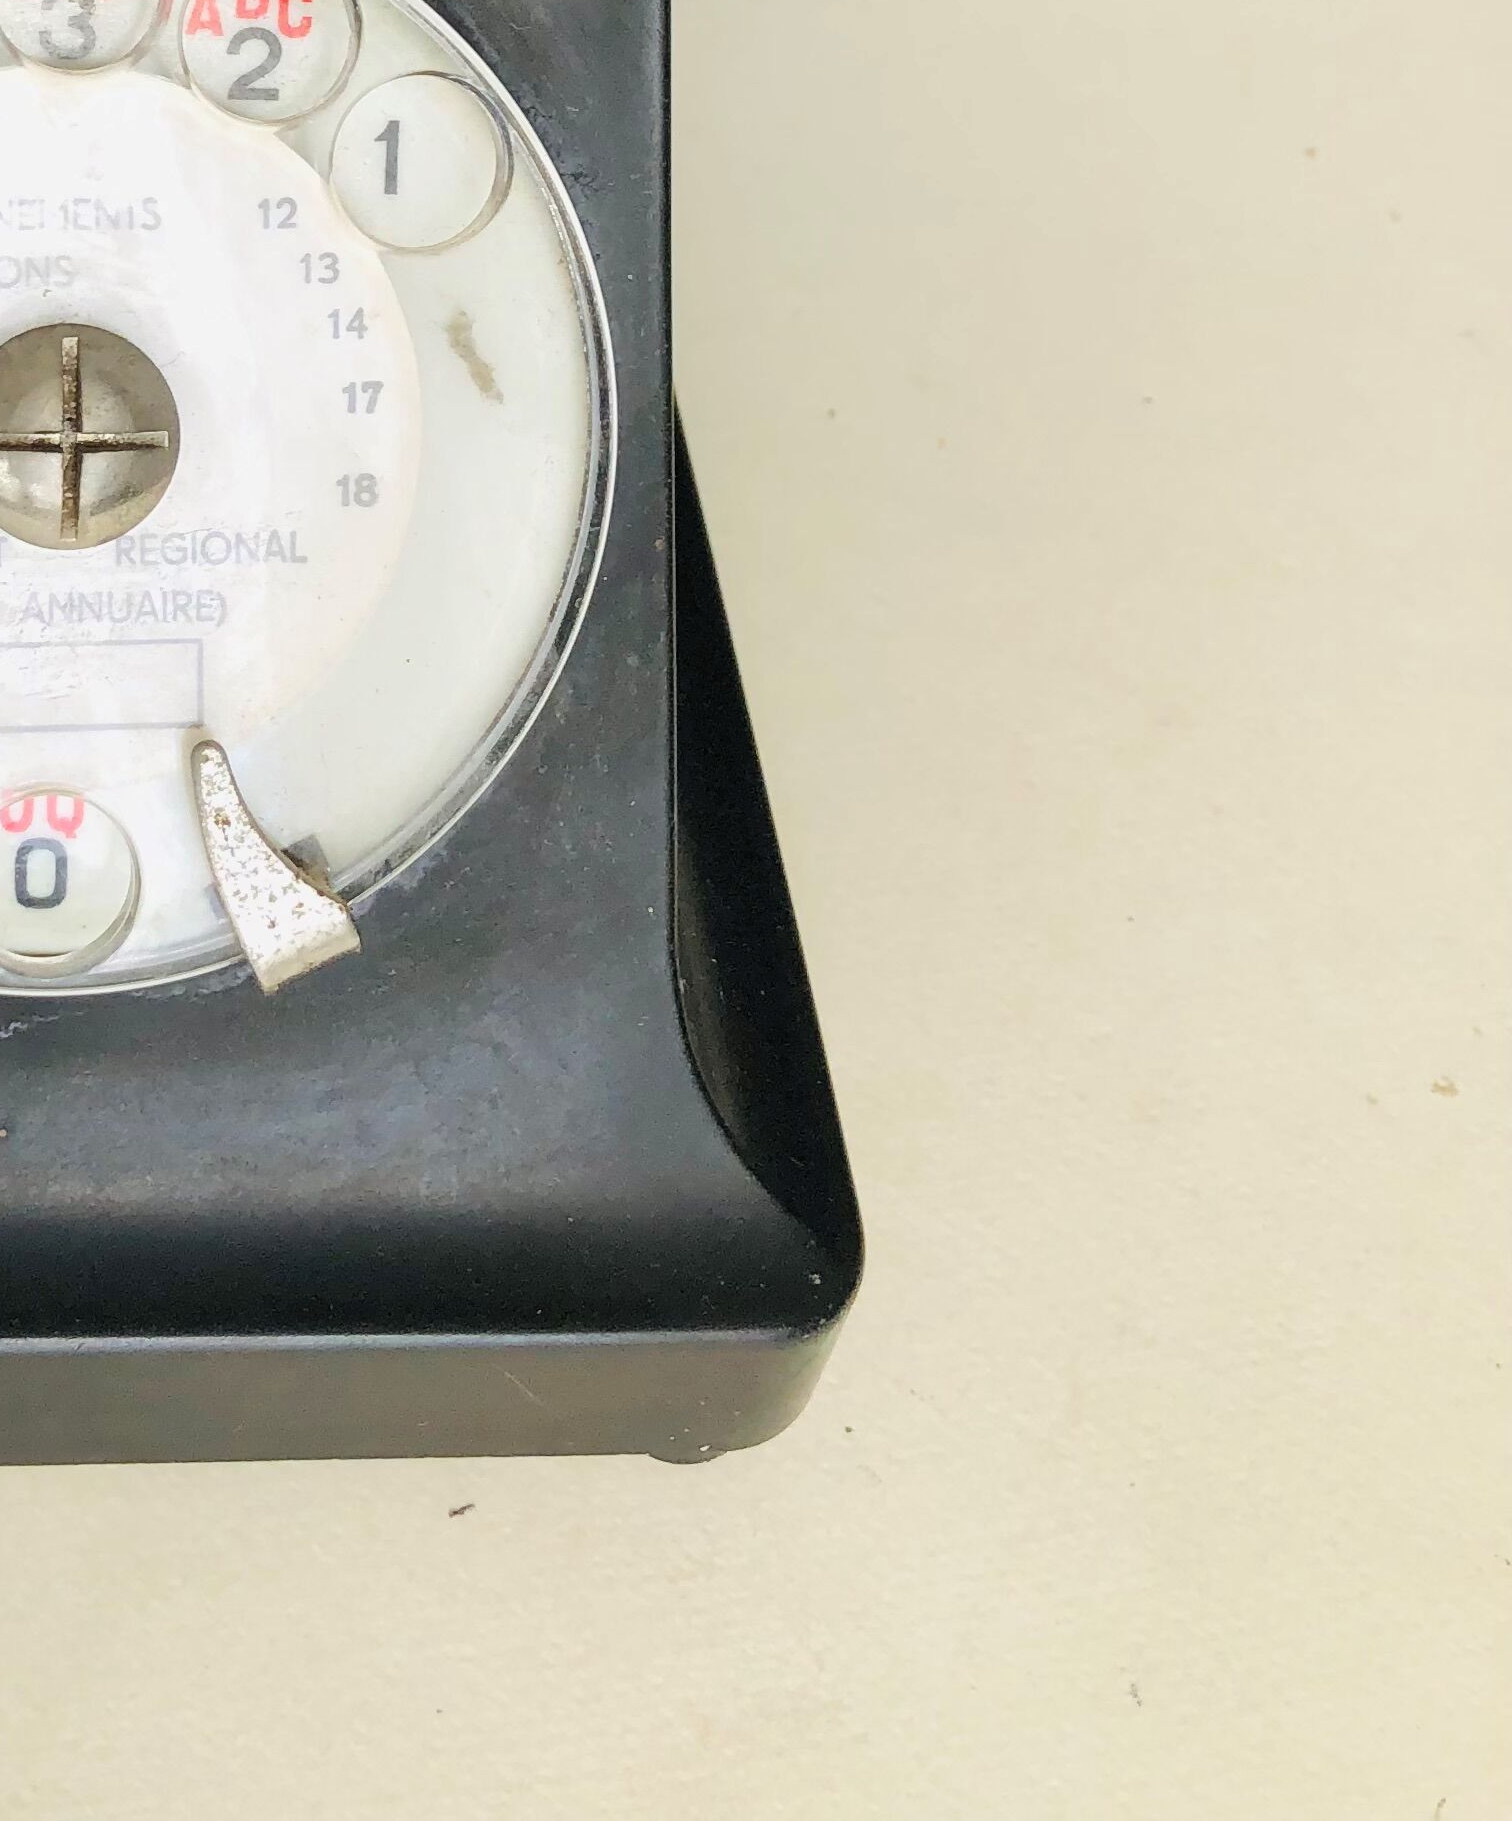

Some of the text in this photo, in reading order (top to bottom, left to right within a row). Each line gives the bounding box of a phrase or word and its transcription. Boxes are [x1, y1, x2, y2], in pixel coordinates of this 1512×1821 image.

[226, 26, 283, 101] 2
[373, 119, 401, 196] 1
[257, 196, 299, 229] 12
[299, 252, 341, 284] 13
[327, 307, 368, 340] 14
[342, 381, 385, 415] 17
[335, 472, 380, 508] 18
[115, 528, 308, 568] REGIONAL
